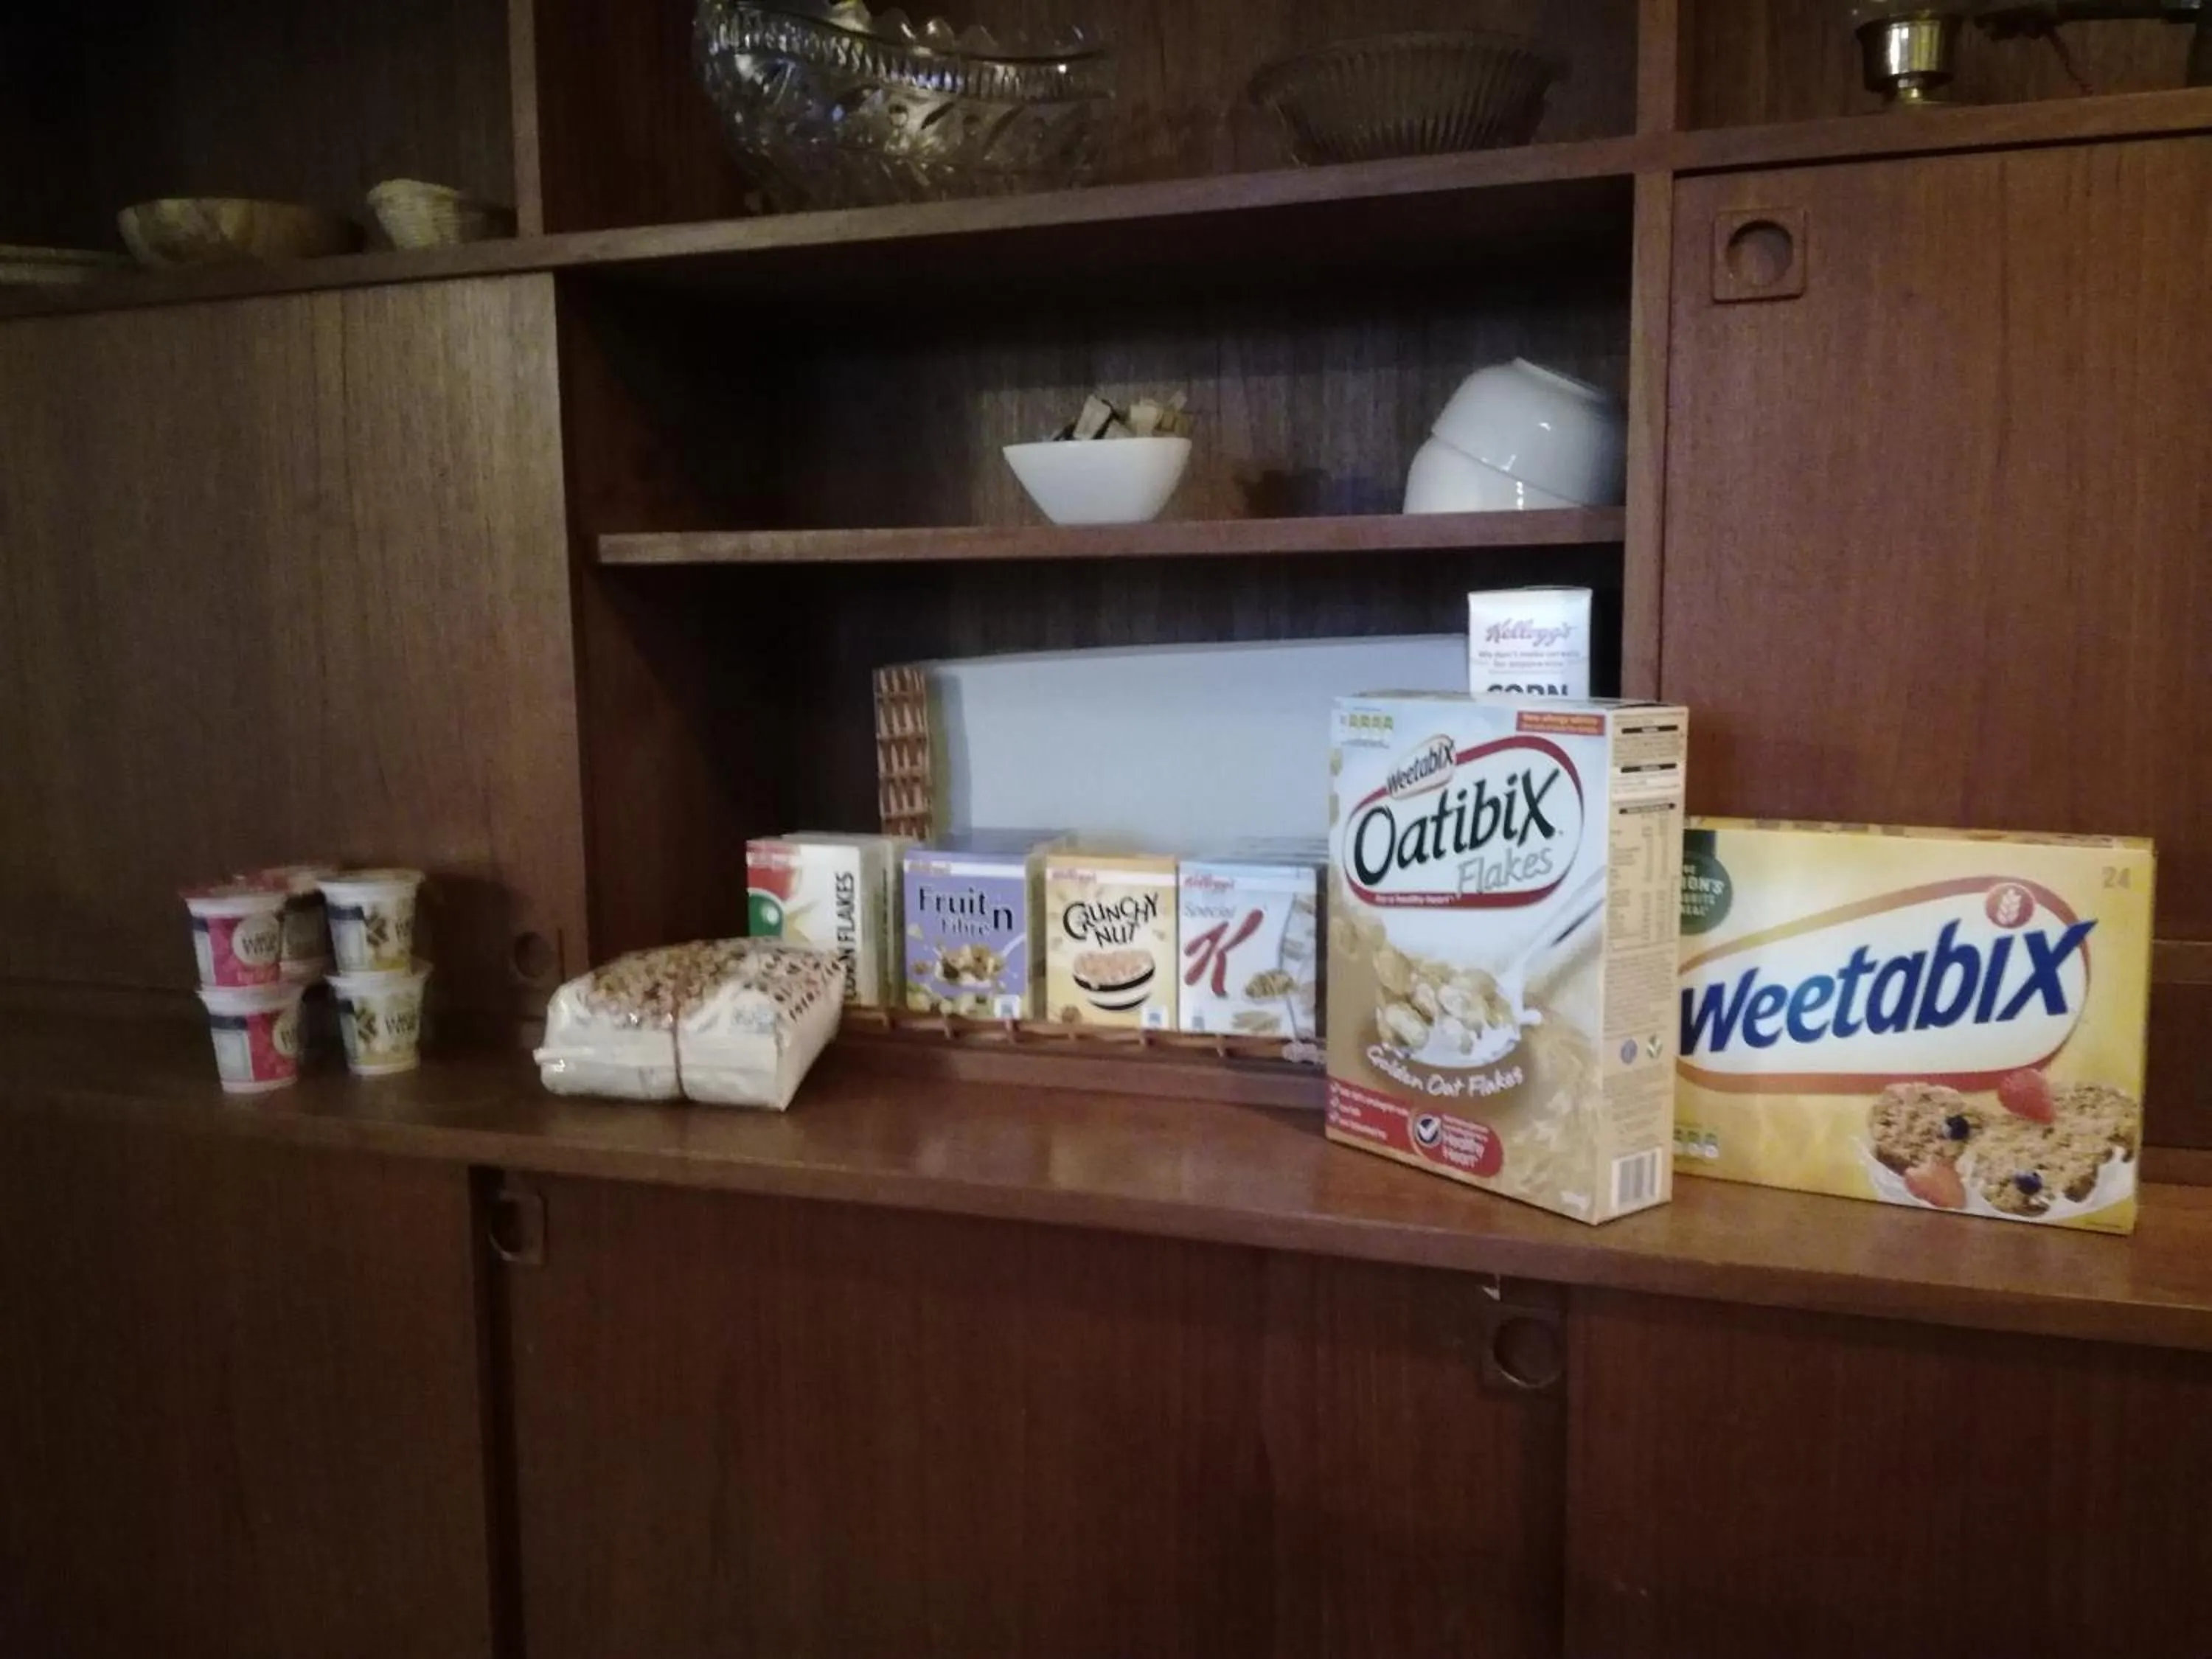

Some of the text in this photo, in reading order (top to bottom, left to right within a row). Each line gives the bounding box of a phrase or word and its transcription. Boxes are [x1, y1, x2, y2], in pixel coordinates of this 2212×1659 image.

[1455, 848, 1554, 900] Flakes
[2101, 865, 2130, 889] 24
[836, 871, 856, 942] FLAKES
[919, 887, 1012, 930] Fruit n
[1062, 892, 1158, 941] CRUNCHY
[1095, 921, 1140, 947] NUT
[1183, 908, 1265, 998] K
[1680, 919, 2099, 1056] Weetabix
[1427, 1074, 1464, 1097] Oat
